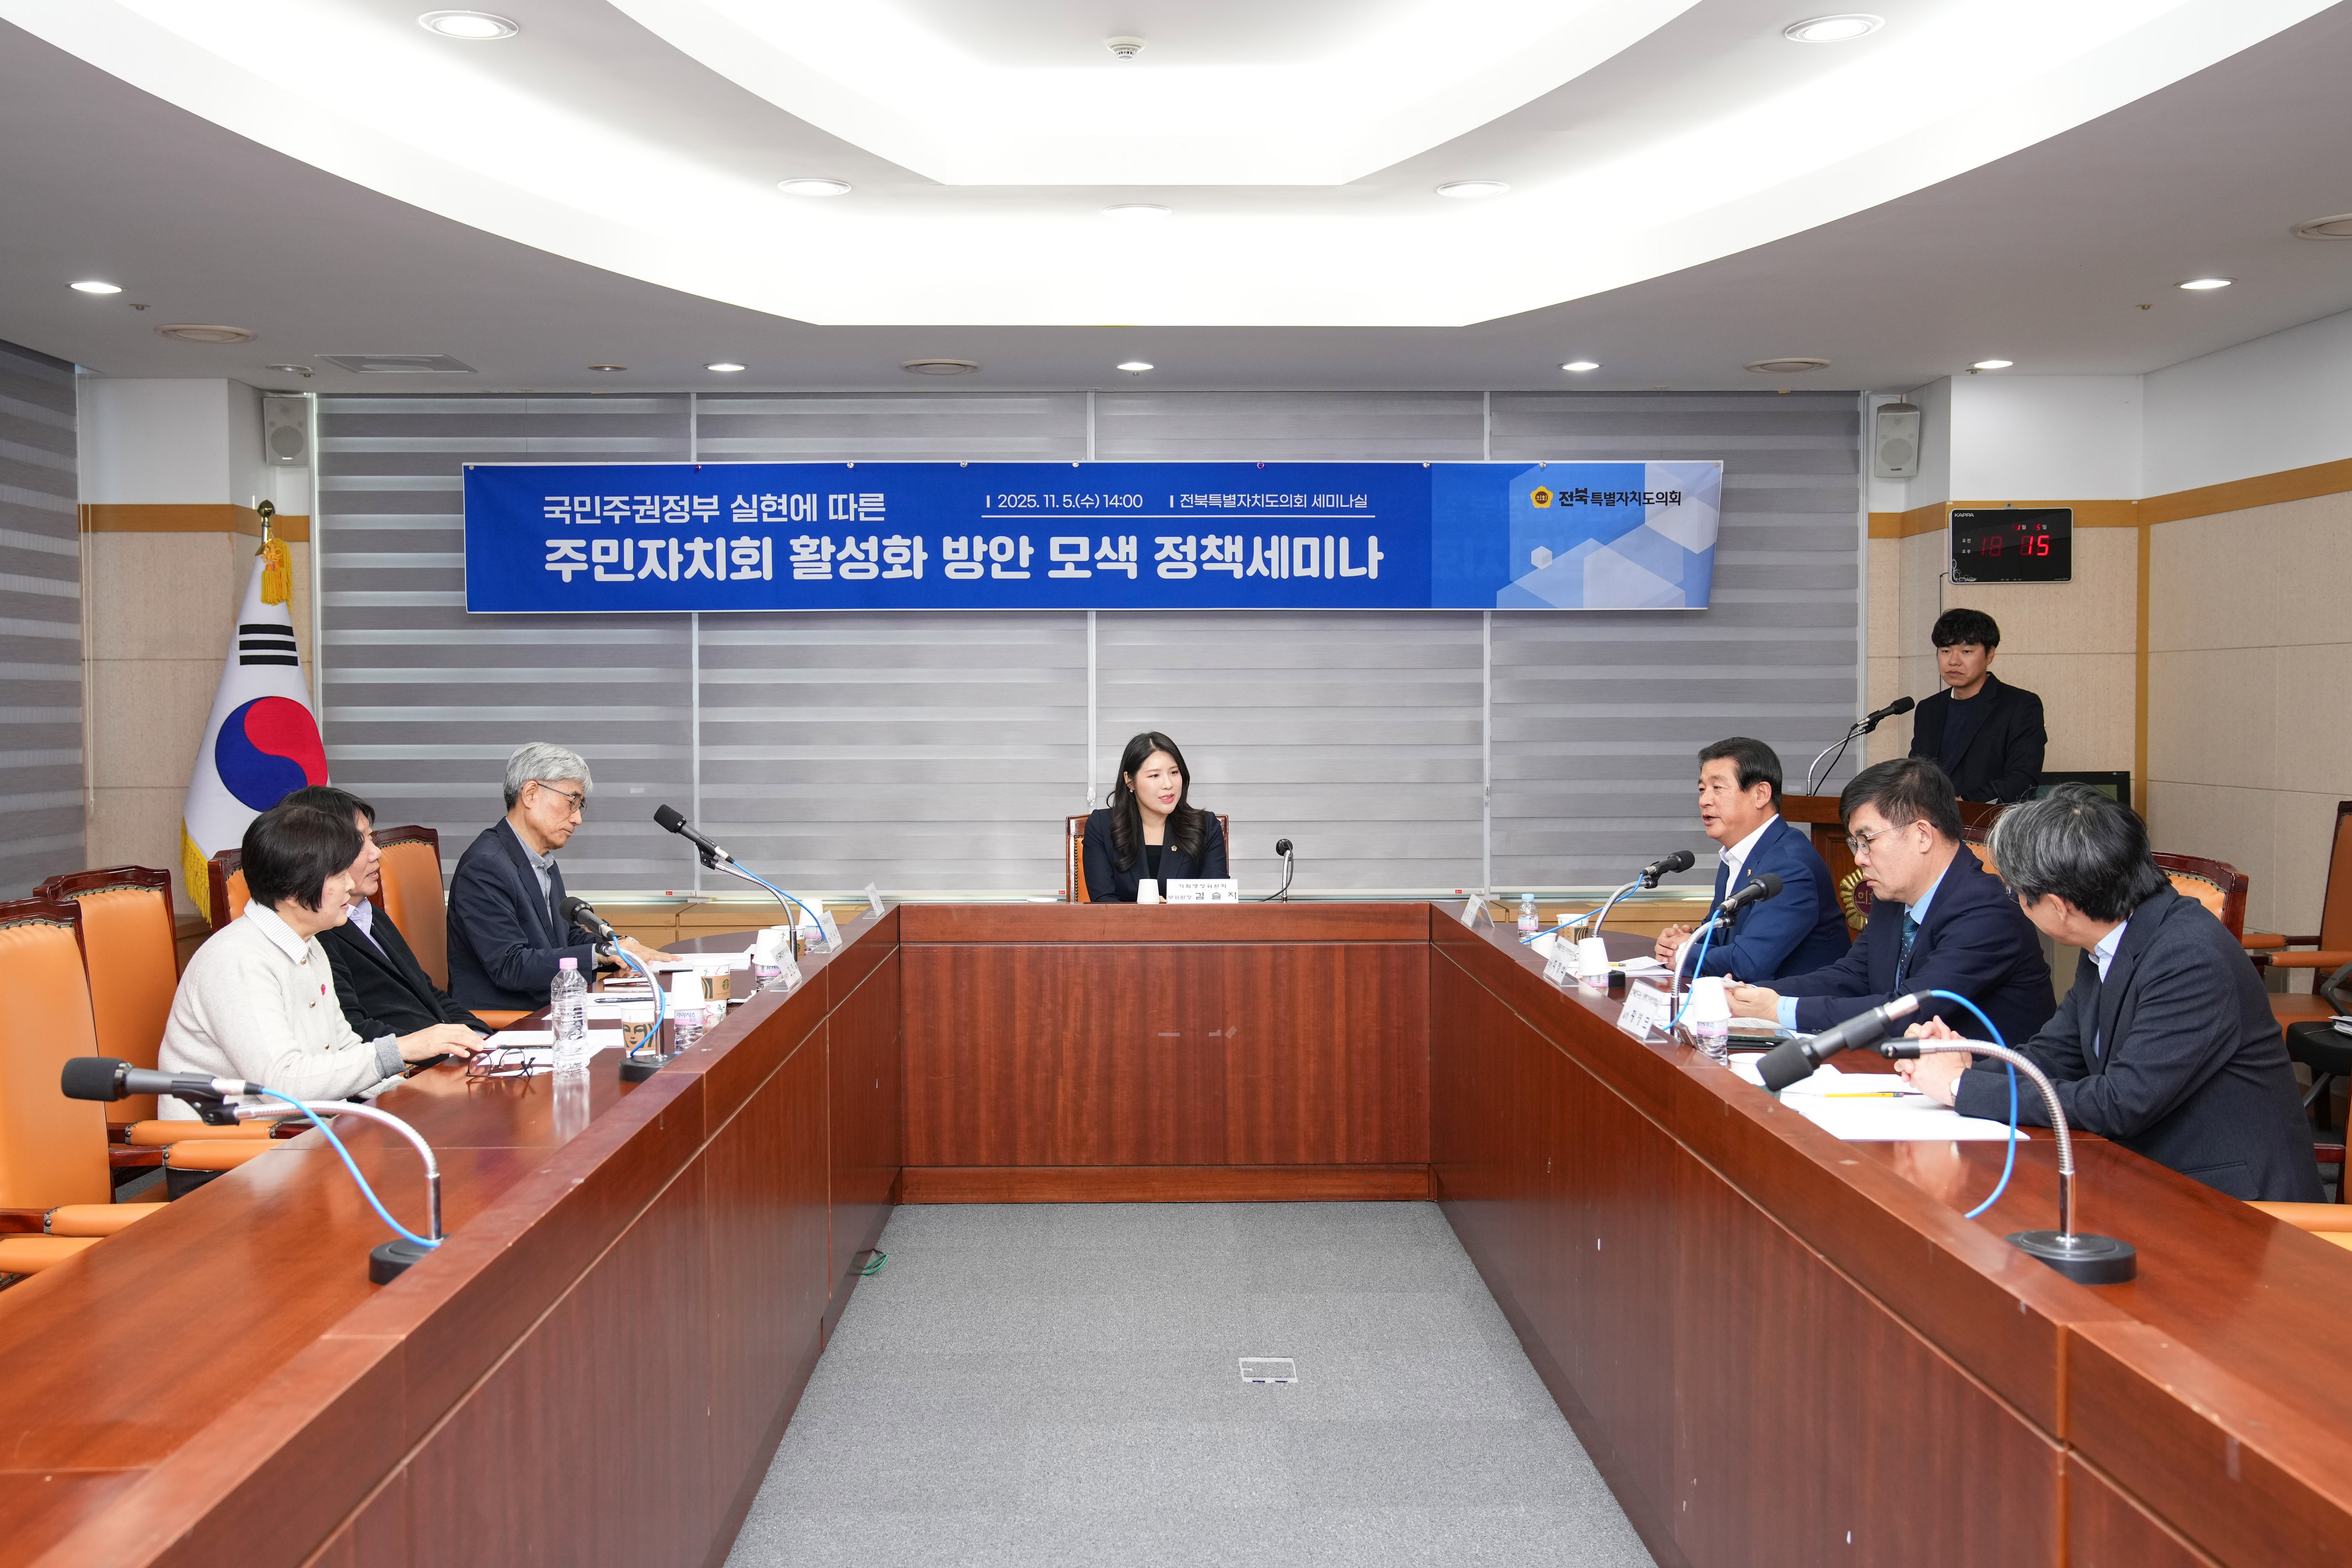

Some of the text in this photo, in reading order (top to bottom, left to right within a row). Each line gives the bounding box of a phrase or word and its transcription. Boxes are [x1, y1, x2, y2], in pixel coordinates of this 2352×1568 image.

[998, 494, 1143, 508] 2025. 11. 5.(수) 14:00
[1180, 493, 1367, 508] 전북특별자치도의회 세미나실
[1559, 488, 1681, 506] 전북특별자치도의회
[544, 493, 886, 524] 국민주권정부 실현에 따른
[2028, 535, 2049, 556] 15
[545, 534, 1384, 583] 주민자치회 활성화 방안 모색 정책세미나
